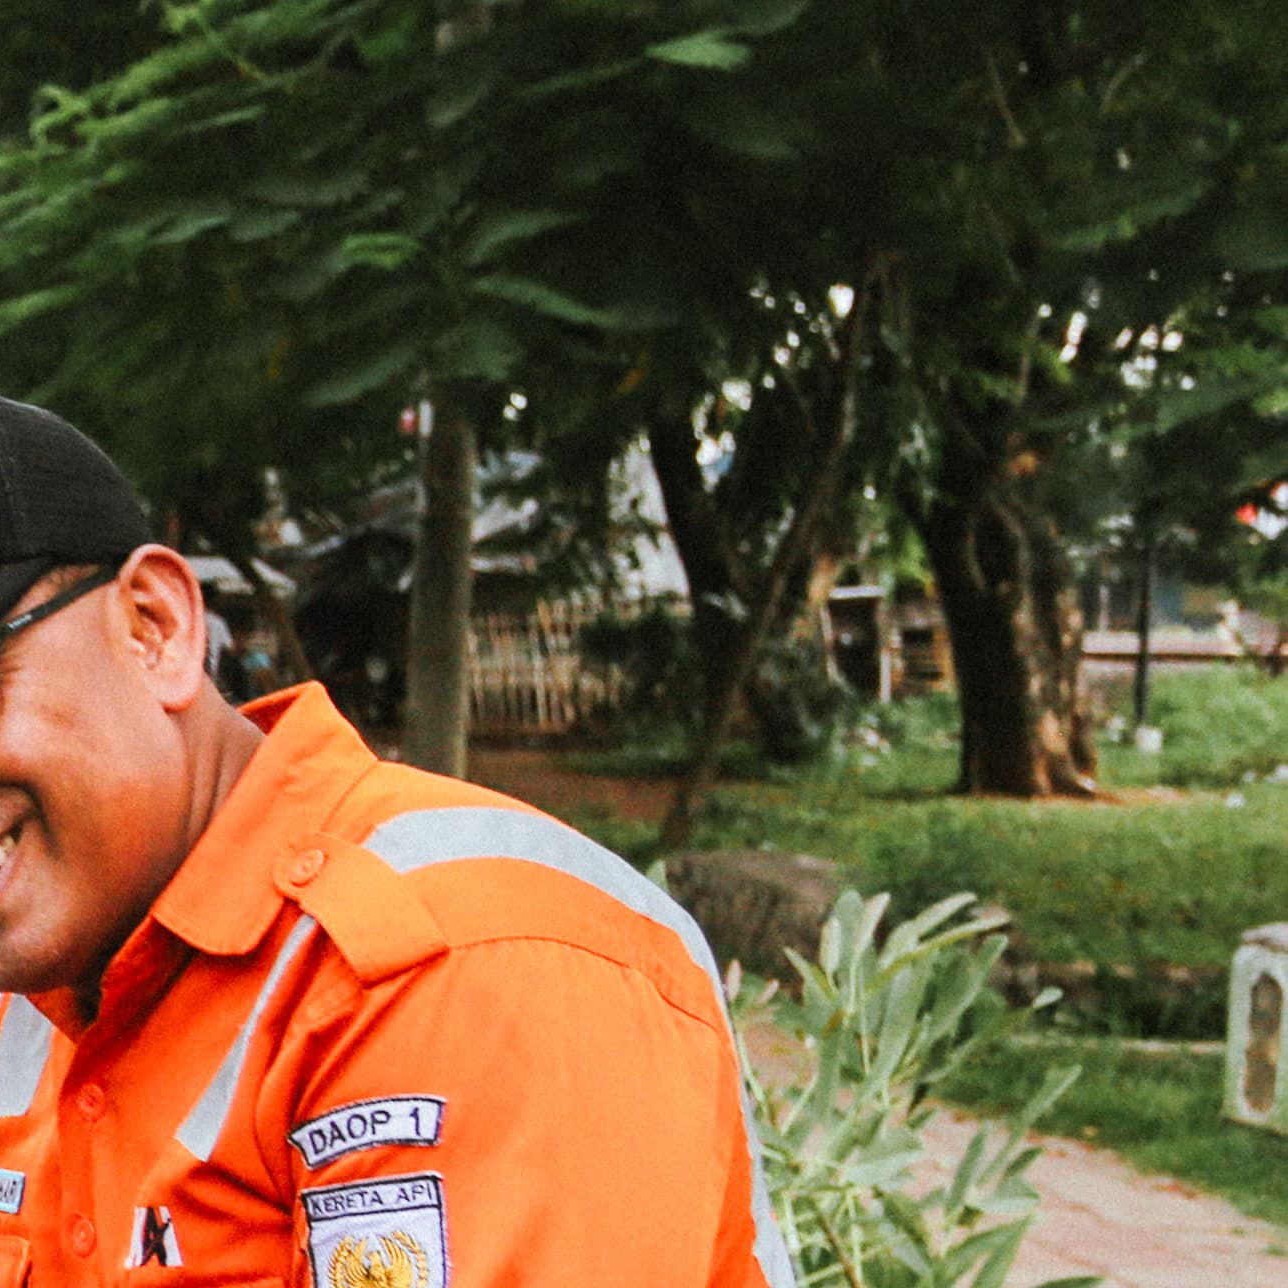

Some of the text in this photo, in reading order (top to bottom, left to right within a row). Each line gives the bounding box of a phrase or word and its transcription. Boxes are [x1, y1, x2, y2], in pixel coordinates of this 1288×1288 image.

[308, 1106, 422, 1156] DAOP 1
[310, 1183, 432, 1217] KERETA API
